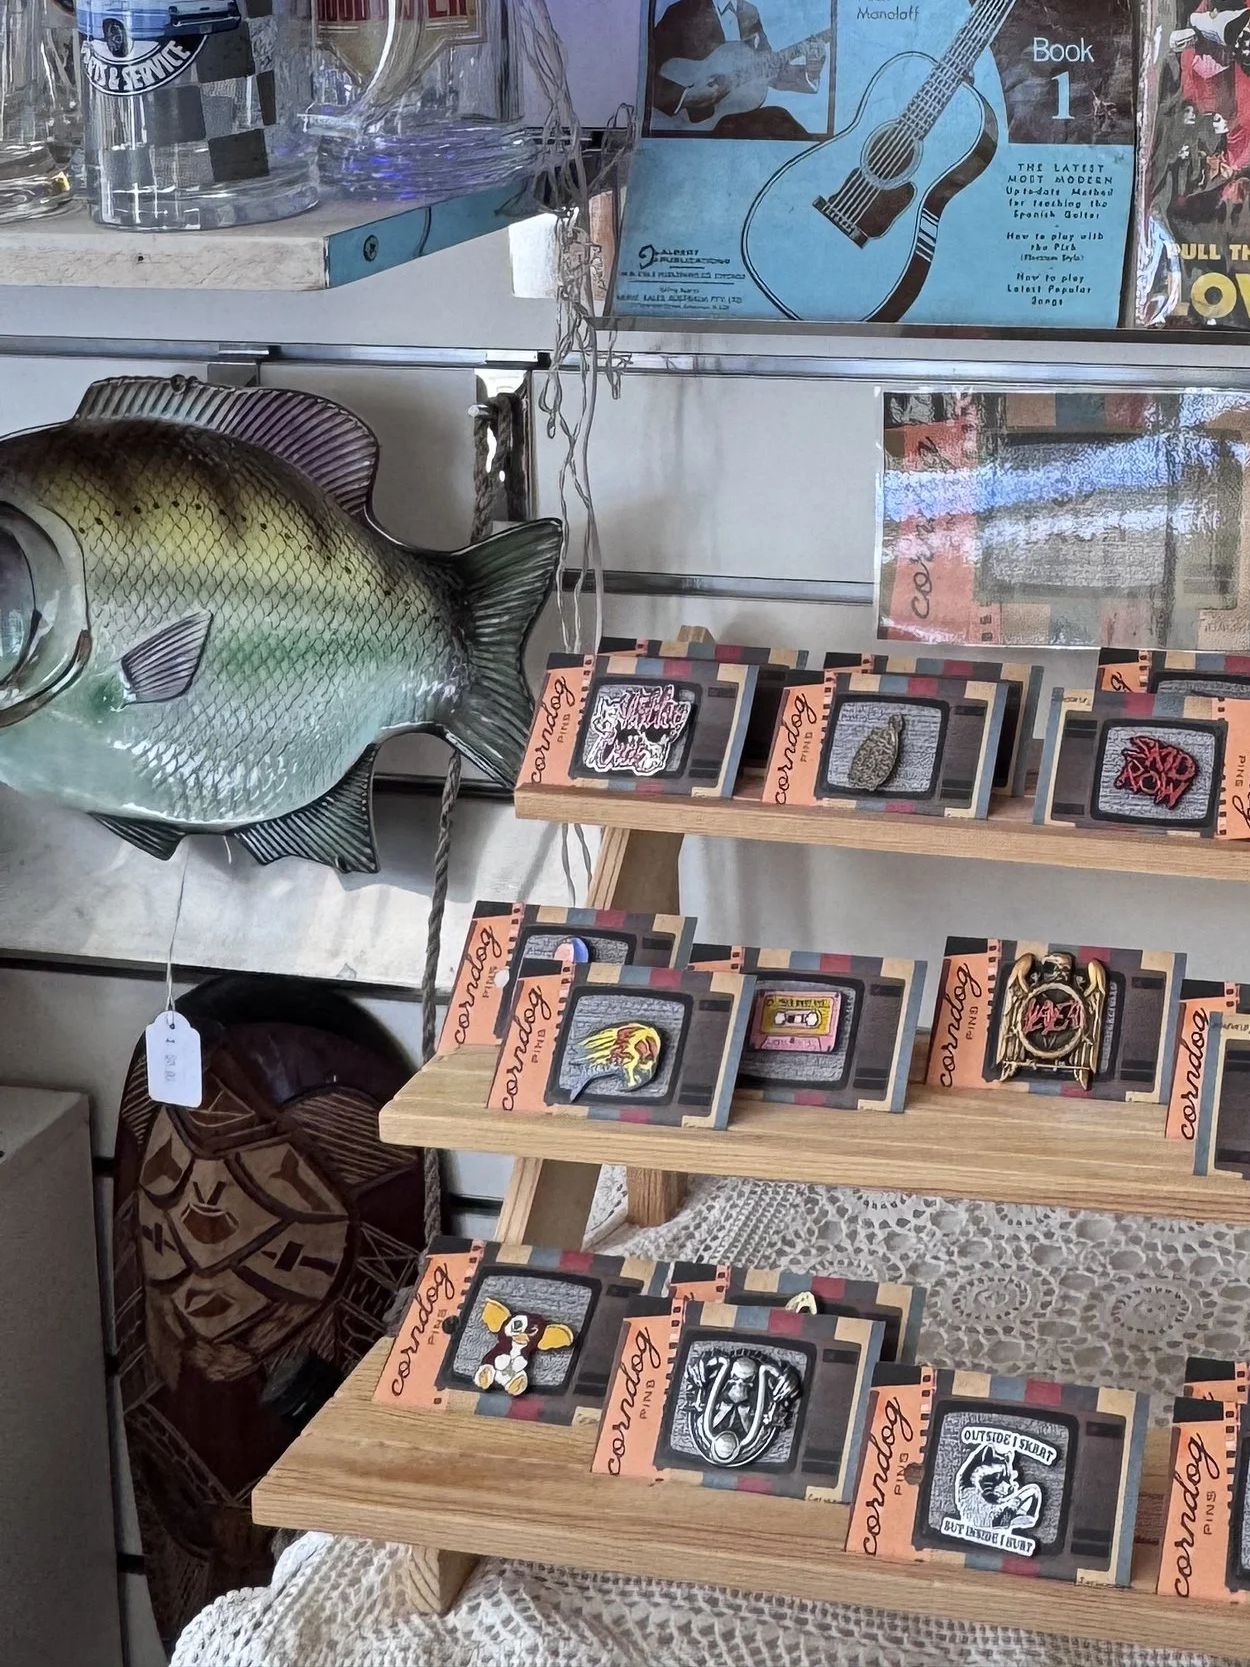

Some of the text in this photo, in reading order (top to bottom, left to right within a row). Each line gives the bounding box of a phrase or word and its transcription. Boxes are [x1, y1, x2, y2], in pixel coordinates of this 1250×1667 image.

[121, 40, 191, 92] SERVICE
[1033, 36, 1095, 63] Book
[1051, 70, 1076, 120] 1
[1007, 175, 1113, 184] MOST MODERN
[1018, 163, 1104, 173] THE LATEST
[1006, 232, 1029, 240] How
[1051, 232, 1075, 242] play
[1013, 210, 1056, 219] Spanish
[1016, 272, 1085, 284] How to play
[1175, 244, 1220, 261] PULL
[1048, 285, 1092, 294] Popular
[531, 676, 575, 783] corndog
[775, 693, 817, 804] corndog
[455, 925, 502, 1044] corndog
[502, 985, 552, 1111] corndog
[941, 963, 982, 1088] corndog
[1181, 1007, 1209, 1140] corndog
[391, 1263, 455, 1396] corndog
[608, 1326, 661, 1475] corndog
[964, 1429, 1010, 1446] OUTSIDE
[863, 1397, 913, 1556] corndog
[943, 1521, 964, 1535] BUT
[1174, 1433, 1220, 1598] corndog
